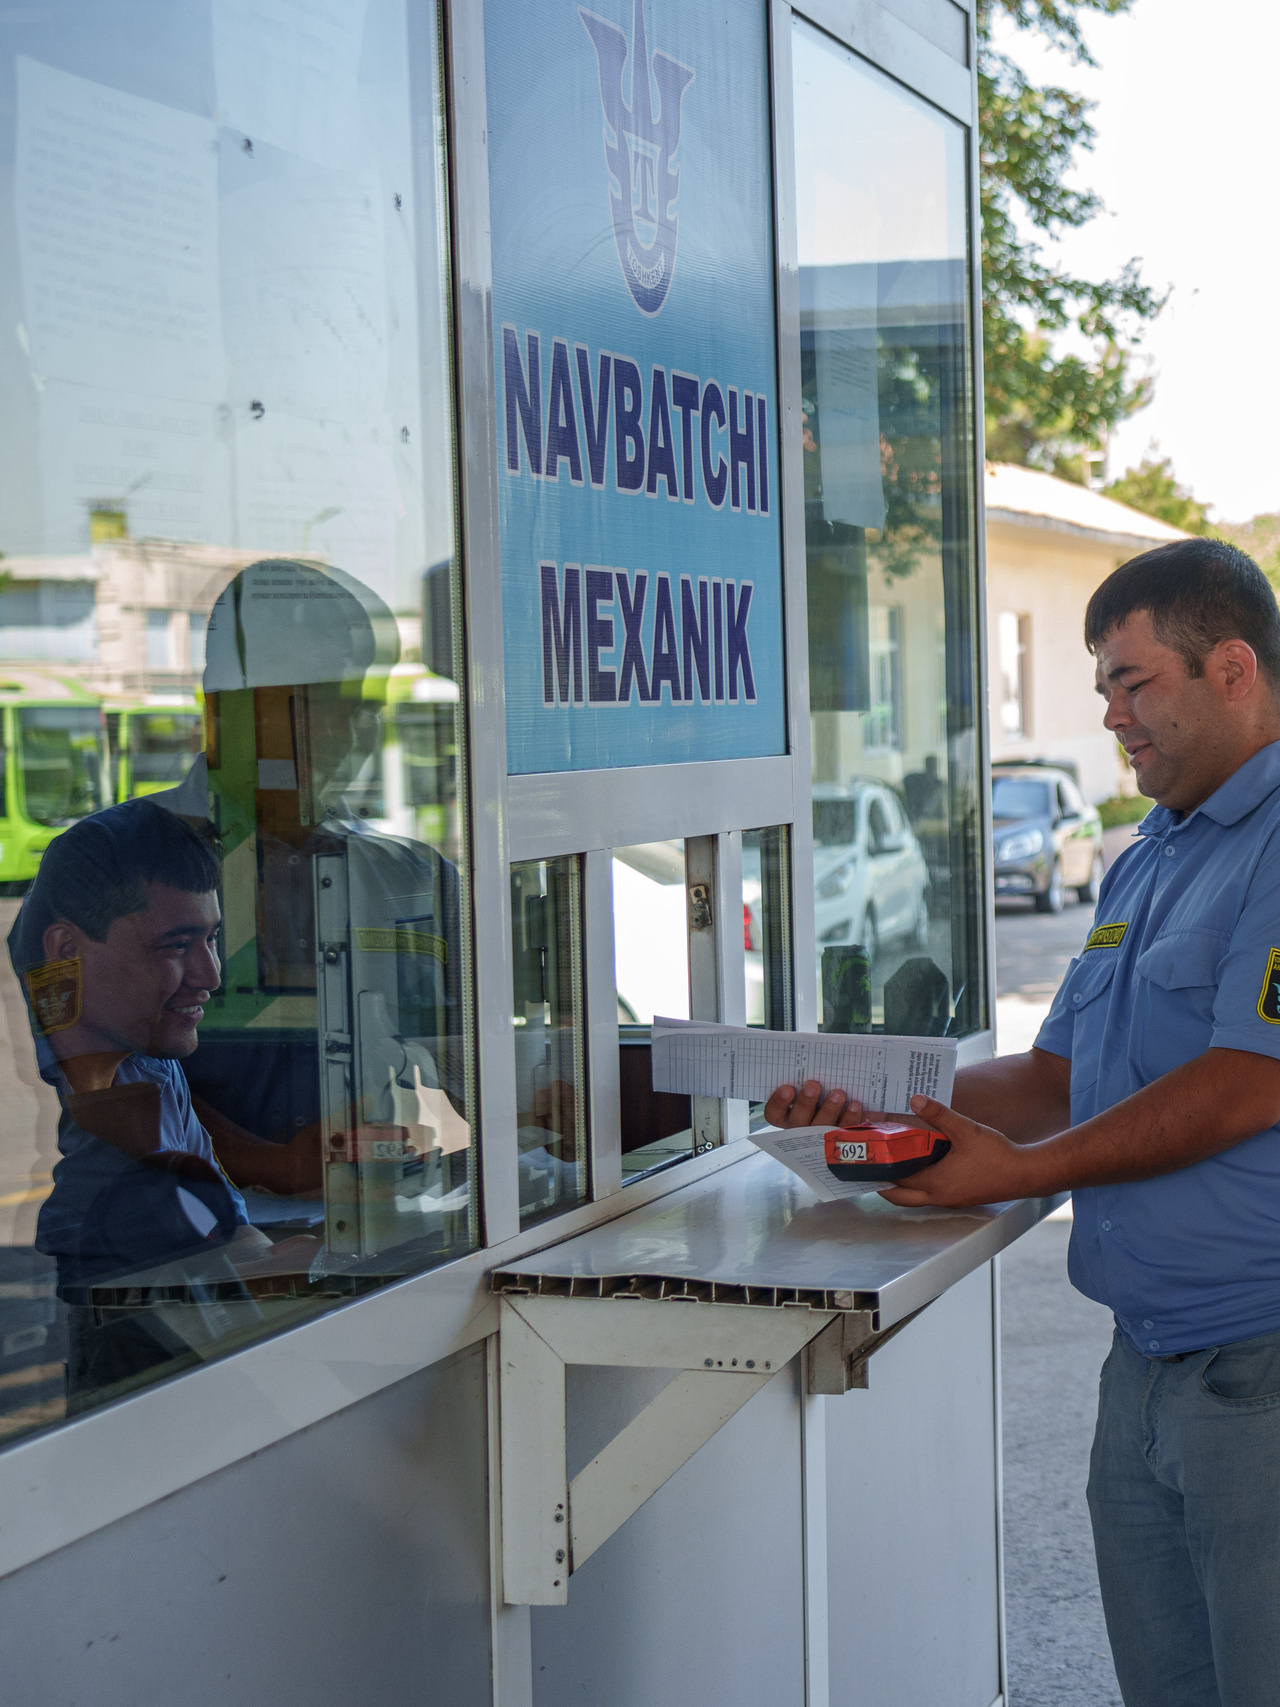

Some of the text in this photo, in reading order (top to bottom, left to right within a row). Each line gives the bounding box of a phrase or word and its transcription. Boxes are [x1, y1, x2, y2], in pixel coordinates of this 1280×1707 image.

[502, 324, 770, 516] NAVBATCHI
[539, 562, 757, 708] MEXANIK
[841, 1144, 865, 1159] 692
